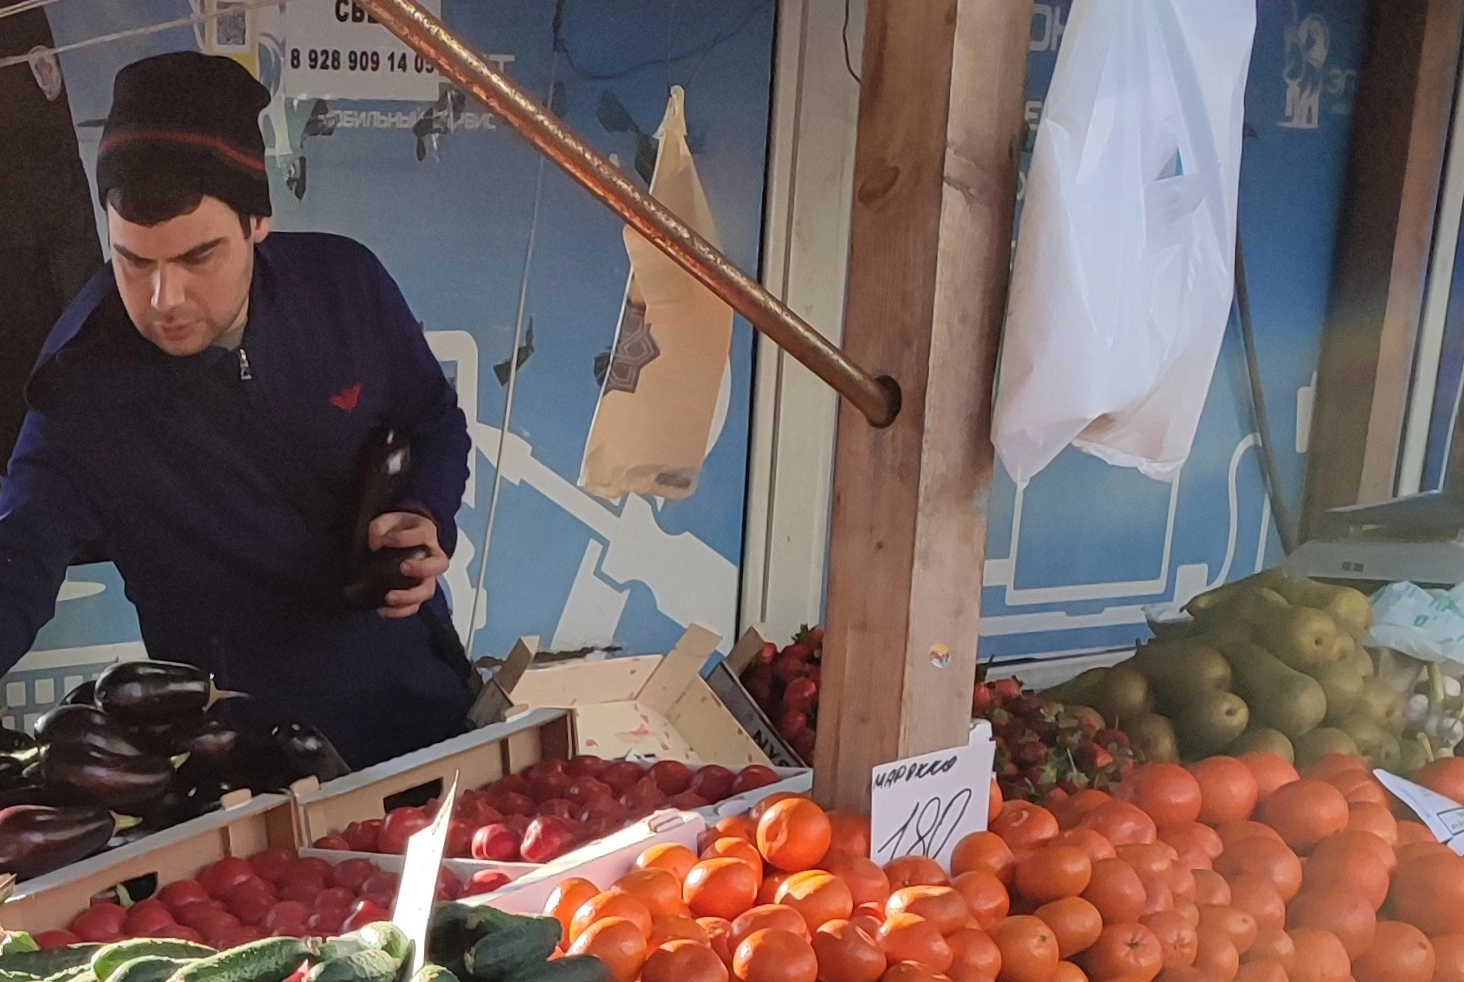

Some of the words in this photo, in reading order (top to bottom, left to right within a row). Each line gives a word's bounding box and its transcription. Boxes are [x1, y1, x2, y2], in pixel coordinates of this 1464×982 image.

[290, 48, 301, 69] 8
[308, 49, 341, 71] 928
[348, 50, 380, 72] 909
[387, 51, 408, 73] 14
[877, 788, 972, 861] 180
